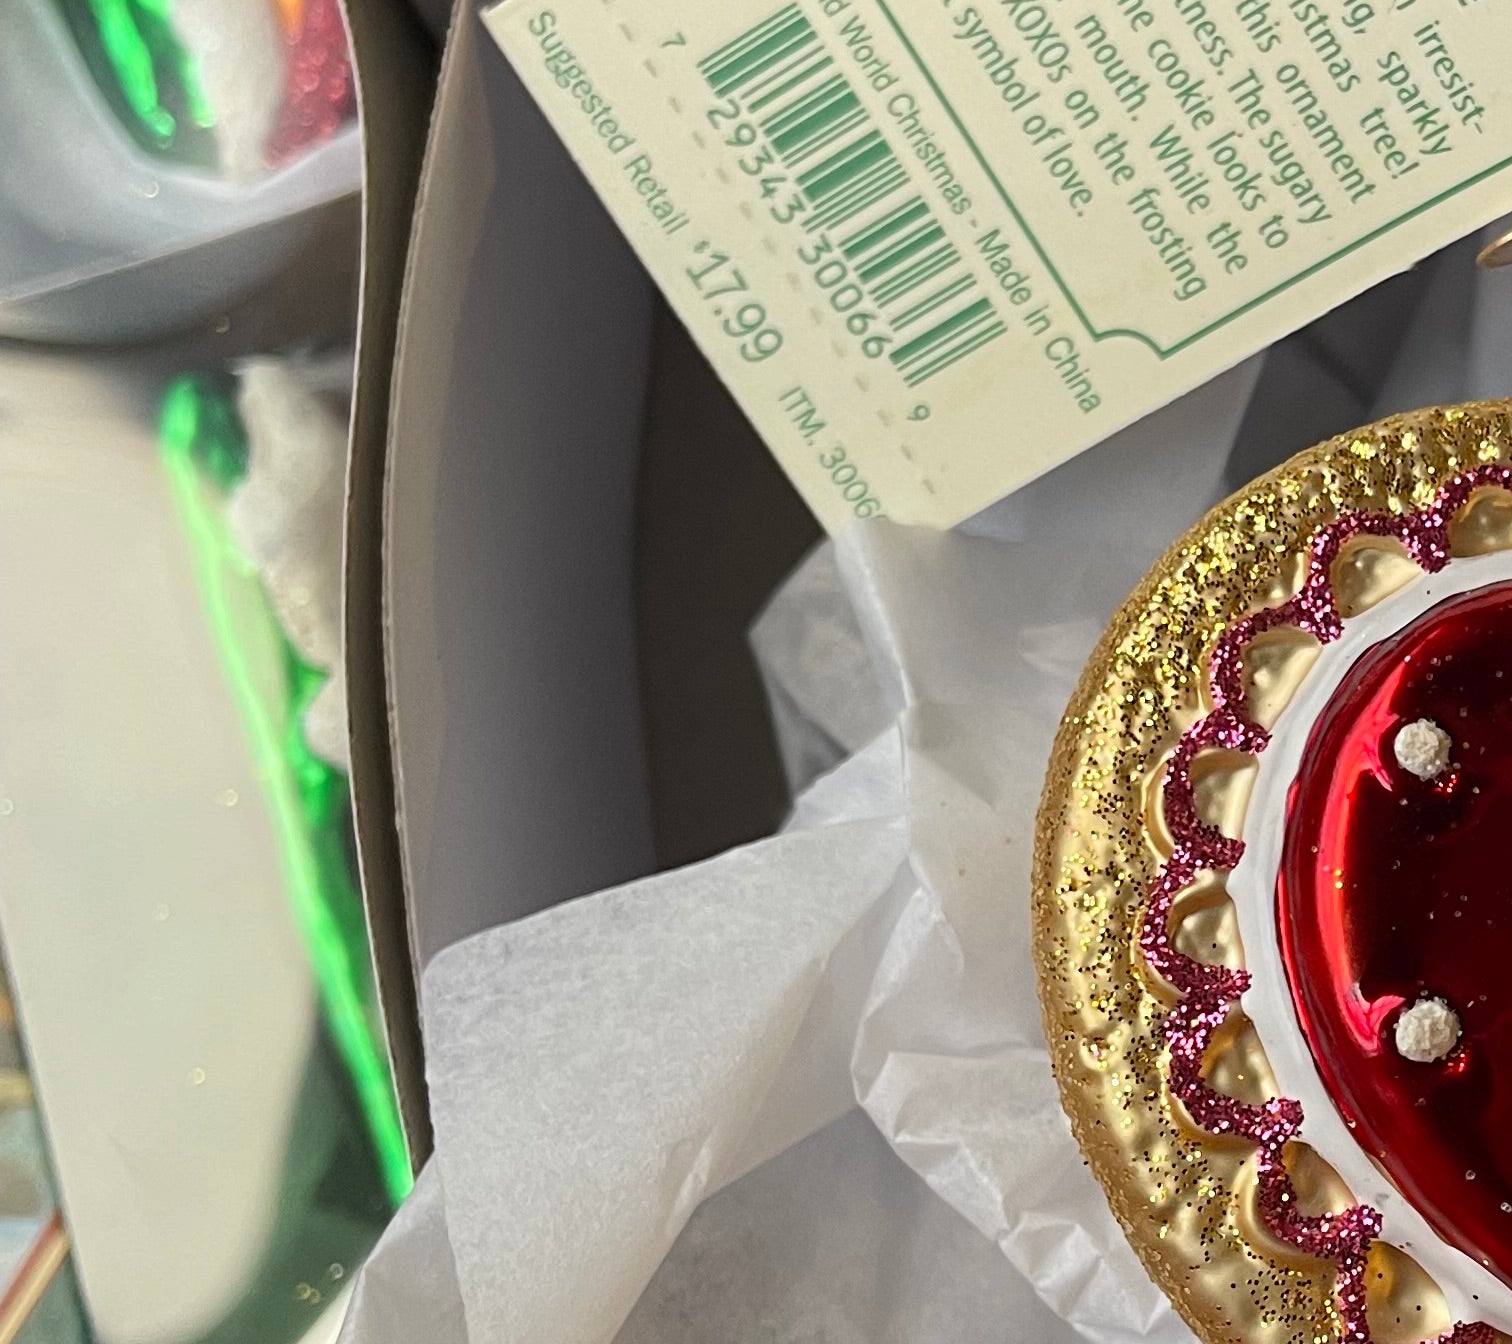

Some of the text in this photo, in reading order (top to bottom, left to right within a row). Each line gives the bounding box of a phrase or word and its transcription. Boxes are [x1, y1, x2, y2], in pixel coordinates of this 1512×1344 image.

[951, 6, 1041, 113] symbol
[1021, 113, 1066, 146] of
[1274, 62, 1377, 205] ornament
[1375, 49, 1453, 156] sparkly
[1412, 18, 1486, 134] irresist-
[837, 13, 900, 93] World
[885, 91, 972, 215] Christmas
[973, 226, 1032, 306] Made
[1022, 303, 1052, 336] in
[1043, 334, 1101, 415] China
[1041, 141, 1093, 217] love.
[1063, 88, 1101, 130] on
[1092, 130, 1136, 186] the
[1126, 186, 1208, 302] frosting
[1073, 12, 1151, 122] mouth.
[1147, 122, 1211, 215] While
[1204, 220, 1248, 275] the
[1146, 37, 1215, 131] cookie
[1205, 128, 1267, 212] looks
[1257, 213, 1290, 249] to
[1226, 66, 1272, 130] The
[1257, 128, 1334, 224] sugary
[1358, 105, 1421, 180] tree!
[527, 9, 636, 154] Suggested
[622, 152, 690, 235] Retail
[684, 238, 784, 363] $17.99
[777, 384, 827, 446] ITM.
[660, 30, 931, 422] 7 29343 30066 9
